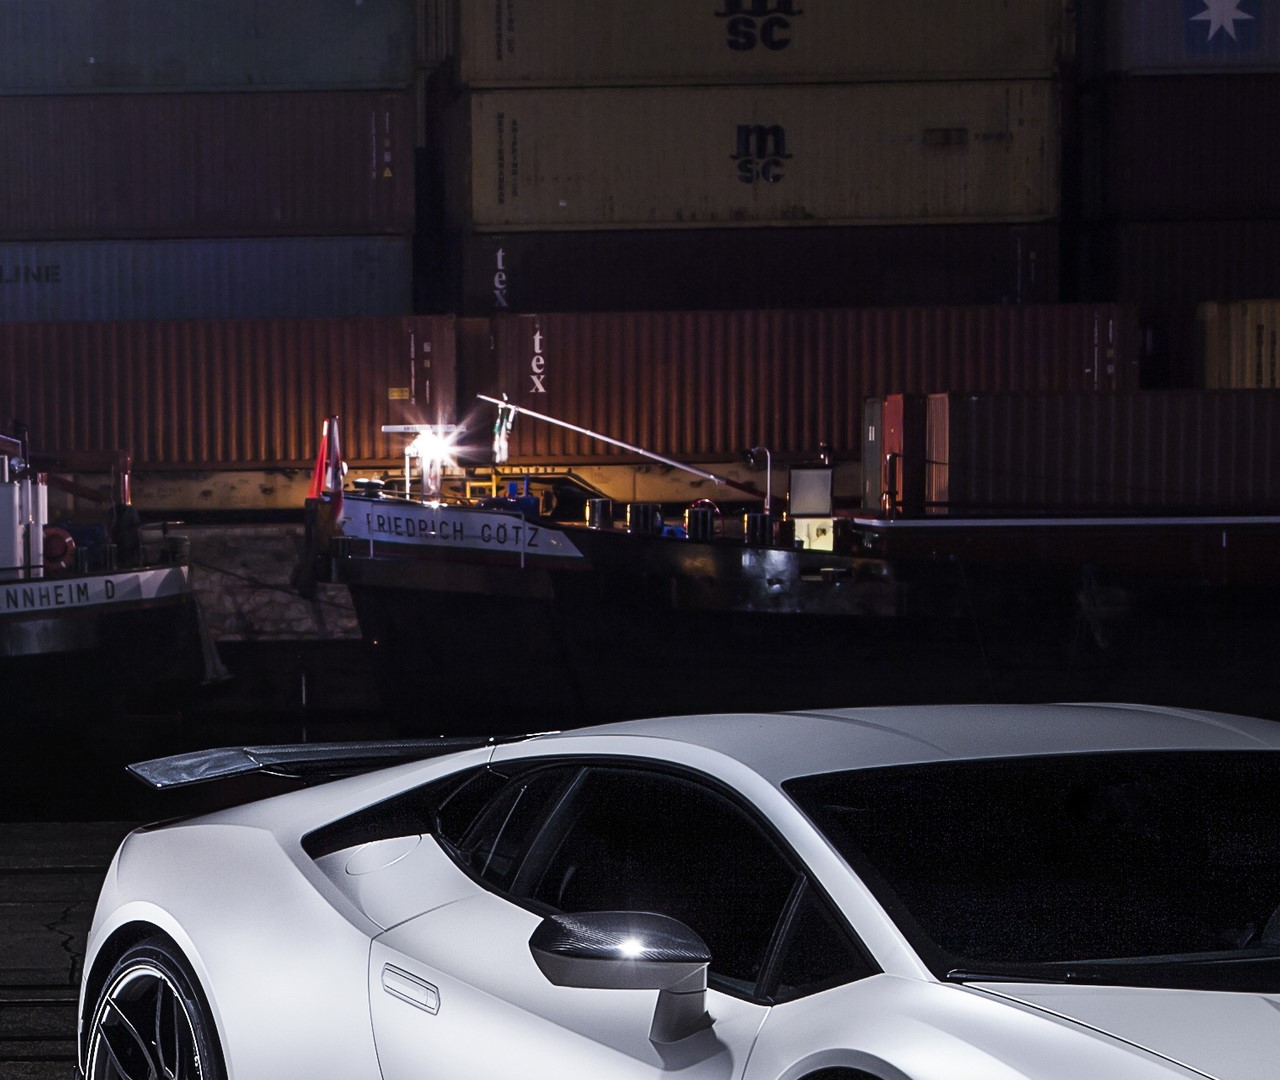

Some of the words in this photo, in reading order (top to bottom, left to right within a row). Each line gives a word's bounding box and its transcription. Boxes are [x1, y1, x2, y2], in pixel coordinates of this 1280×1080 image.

[493, 248, 508, 307] tex
[529, 330, 547, 393] tex
[366, 513, 464, 541] FRIEDRICH
[481, 523, 539, 547] GÖTZ
[105, 580, 115, 600] D
